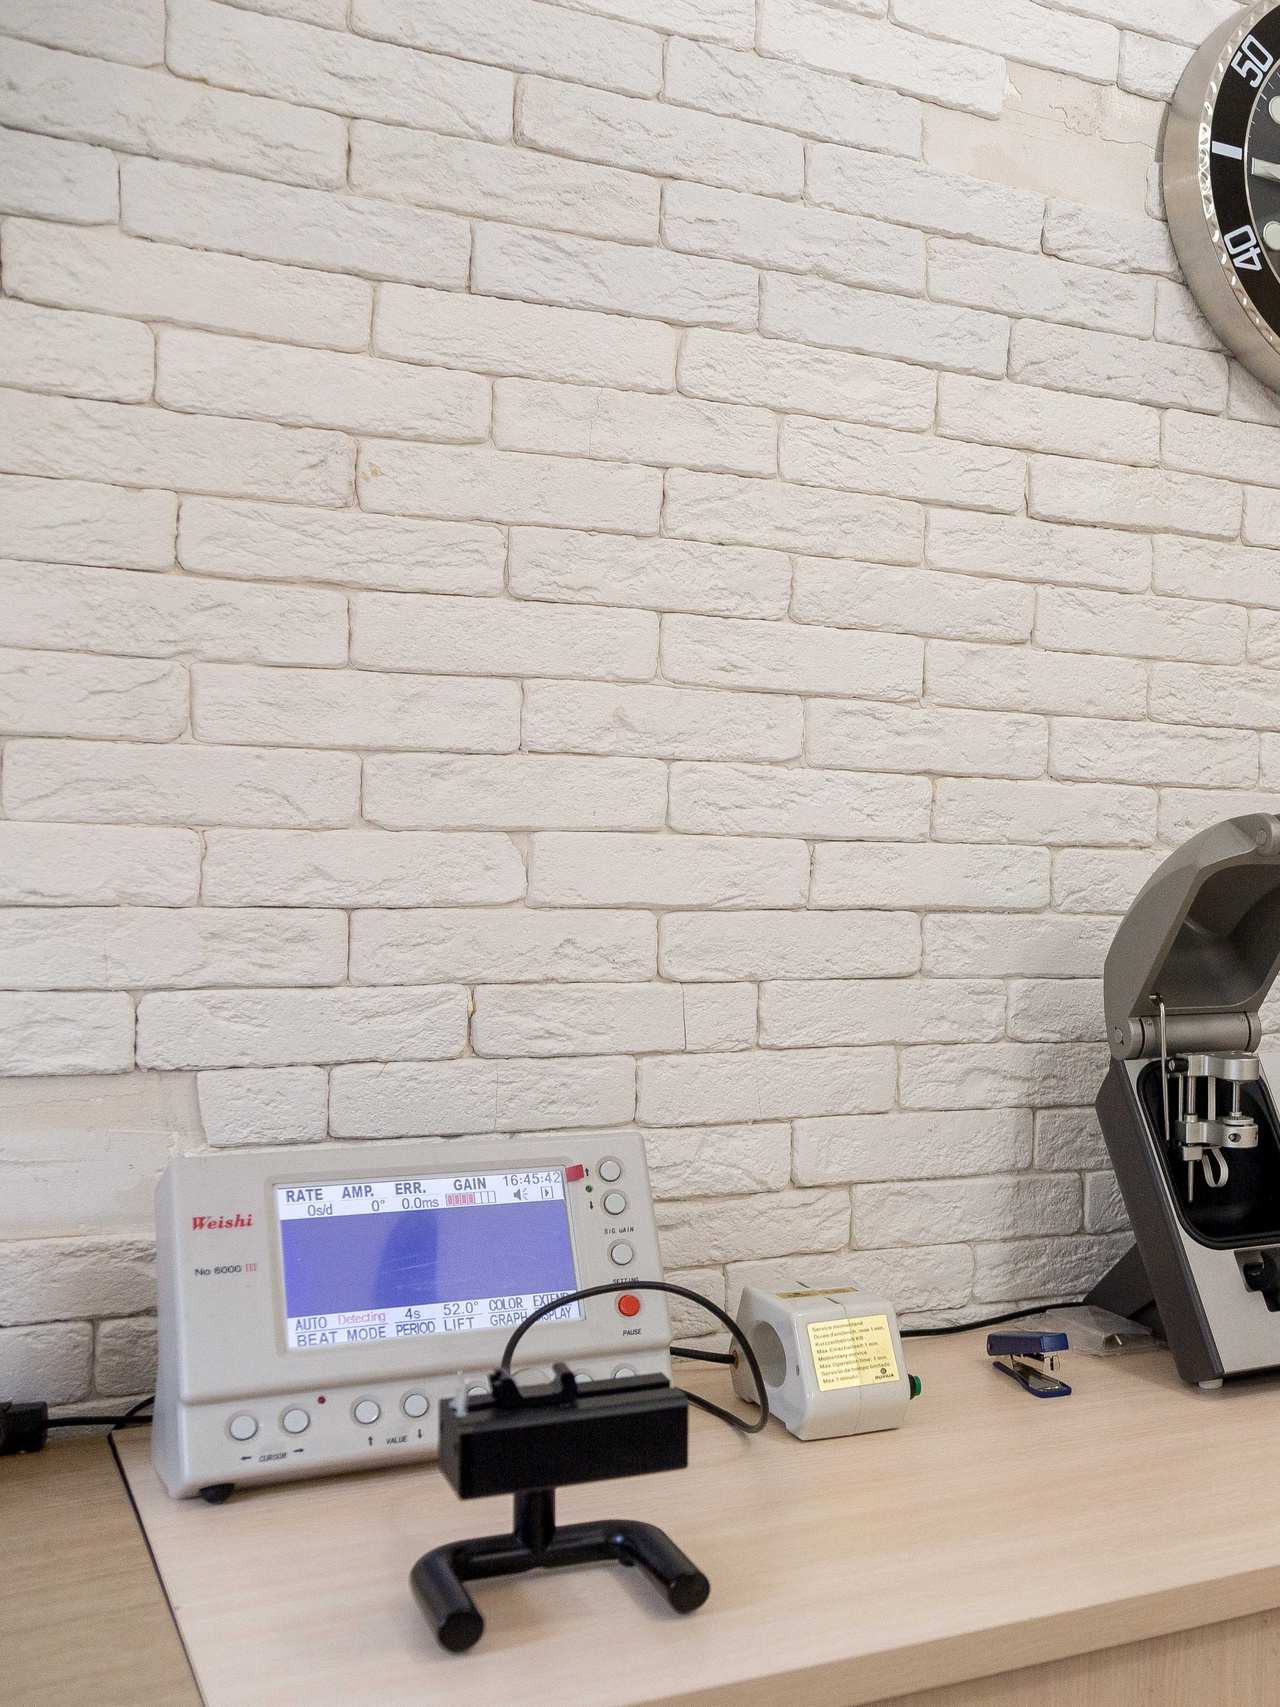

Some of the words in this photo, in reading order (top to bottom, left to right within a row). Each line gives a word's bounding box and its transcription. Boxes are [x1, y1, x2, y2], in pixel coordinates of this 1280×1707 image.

[1231, 34, 1274, 88] 50
[1224, 224, 1263, 271] 40
[286, 1188, 323, 1202] RATE
[342, 1185, 374, 1199] AMP.
[395, 1181, 426, 1195] ERR.
[453, 1177, 487, 1191] GAIN
[503, 1171, 561, 1187] 16:45:42
[308, 1203, 333, 1217] 0s/d
[402, 1197, 440, 1210] 0.0ms
[191, 1213, 253, 1231] Weishi
[214, 1265, 242, 1275] 6000
[295, 1316, 328, 1332] AUTO
[338, 1311, 387, 1326] Detecting
[405, 1307, 421, 1319] 4s
[443, 1300, 479, 1316] 52.0°
[488, 1297, 523, 1312] COLOR
[297, 1331, 338, 1348] BEAT
[347, 1326, 387, 1342] MODE
[396, 1321, 436, 1337] PERIOD
[444, 1317, 474, 1331] LIFT
[490, 1311, 527, 1326] GRAPH
[623, 1328, 642, 1336] PAUSE
[386, 1435, 408, 1445] VALUE
[259, 1452, 288, 1462] CURSOR
